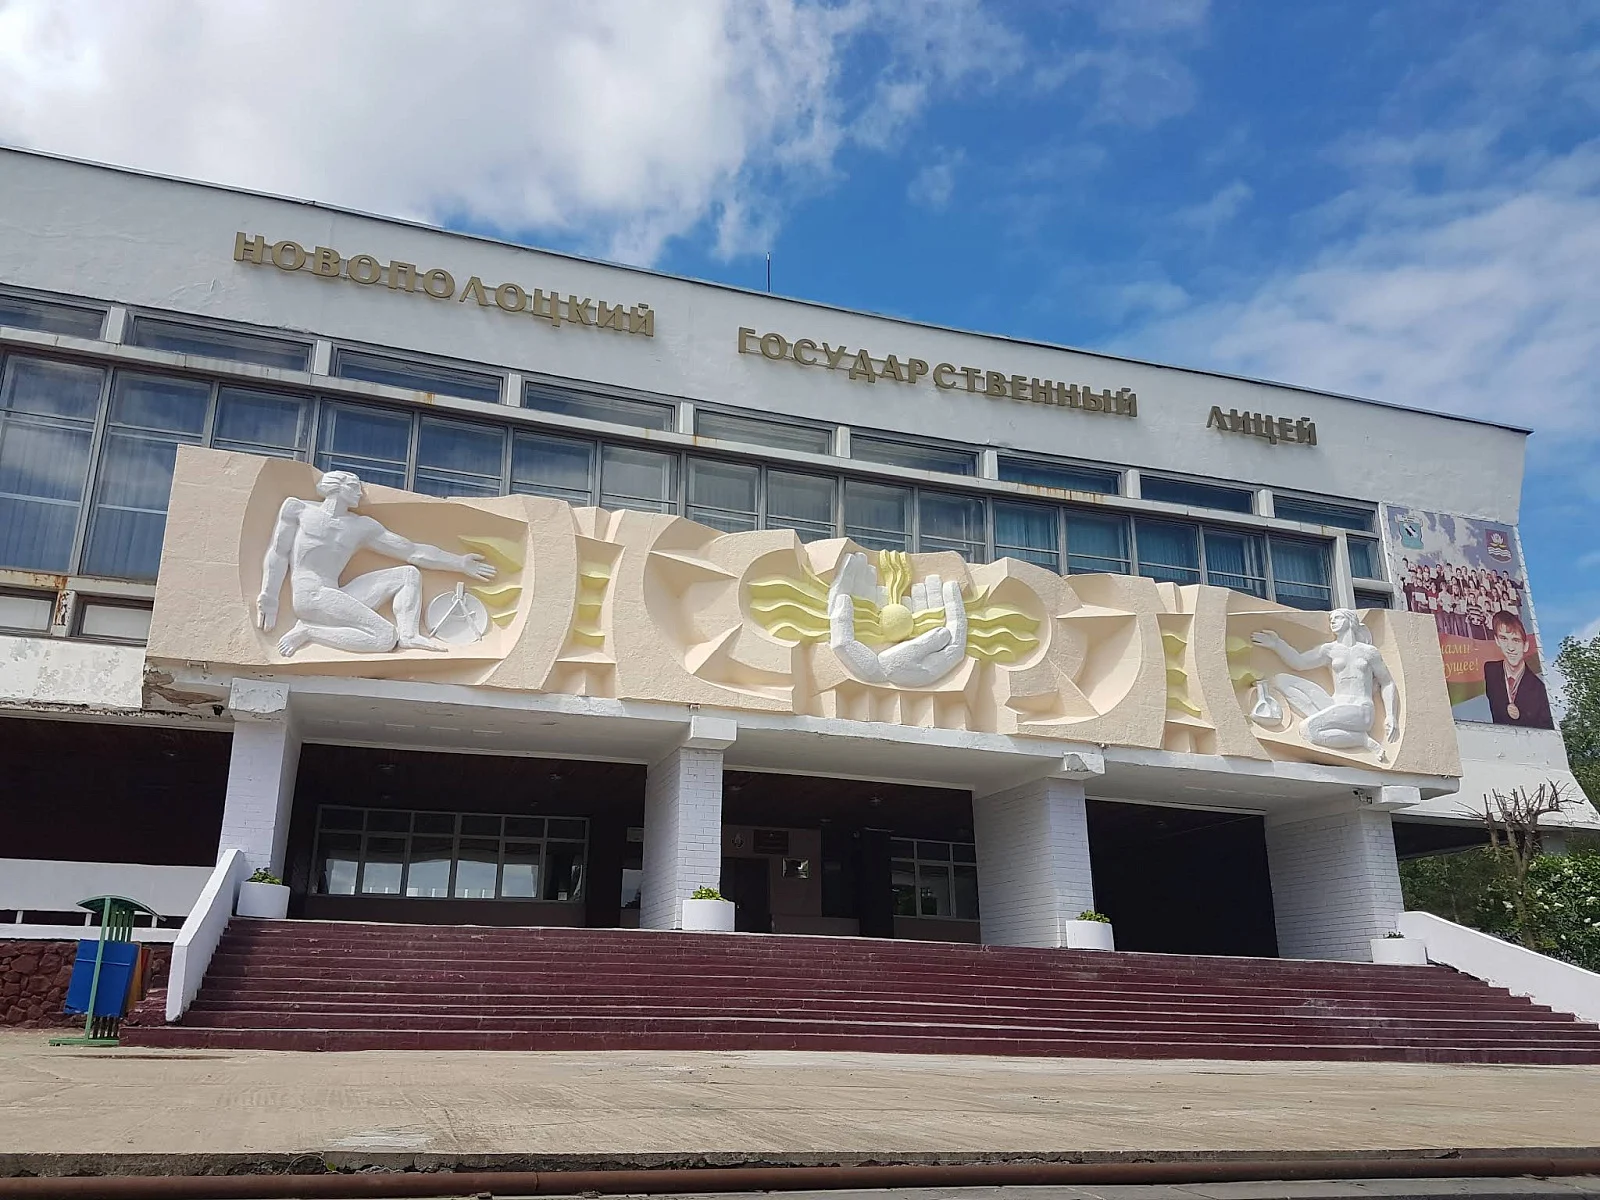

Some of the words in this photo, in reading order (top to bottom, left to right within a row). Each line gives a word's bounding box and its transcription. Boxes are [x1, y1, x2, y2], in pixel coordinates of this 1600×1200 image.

[233, 231, 655, 338] НОВОПОЛОЦКИЙ
[738, 326, 1138, 418] ГОСУДАРСТВЕННЫЙ
[1206, 405, 1318, 445] ЛИЦЕЙ
